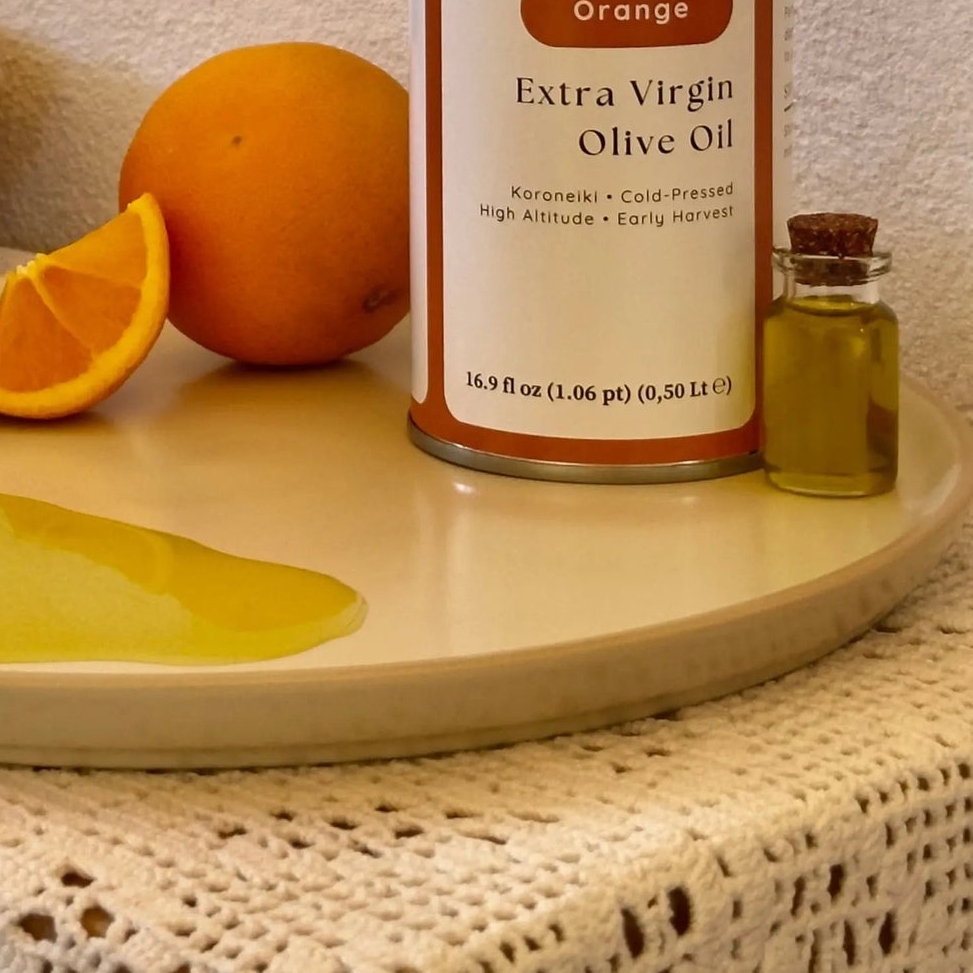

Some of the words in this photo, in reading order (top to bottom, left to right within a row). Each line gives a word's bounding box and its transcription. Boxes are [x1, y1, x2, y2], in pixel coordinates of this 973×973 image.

[573, 0, 689, 25] Orange
[516, 77, 615, 107] Extra
[629, 75, 733, 113] Virgin
[578, 126, 675, 156] Olive
[689, 118, 733, 152] Oil
[511, 185, 598, 204] Koroneiki
[620, 181, 734, 204] Cold-Pressed
[480, 203, 515, 223] High
[522, 208, 595, 226] Altitude
[617, 211, 664, 228] Early
[672, 205, 734, 223] Harvest
[466, 370, 499, 391] 16.9
[502, 376, 516, 395] fl
[519, 383, 542, 398] oz
[546, 381, 597, 403] (1.06
[602, 383, 632, 407] pt)
[637, 382, 686, 405] (0,50
[689, 380, 709, 398] Lt
